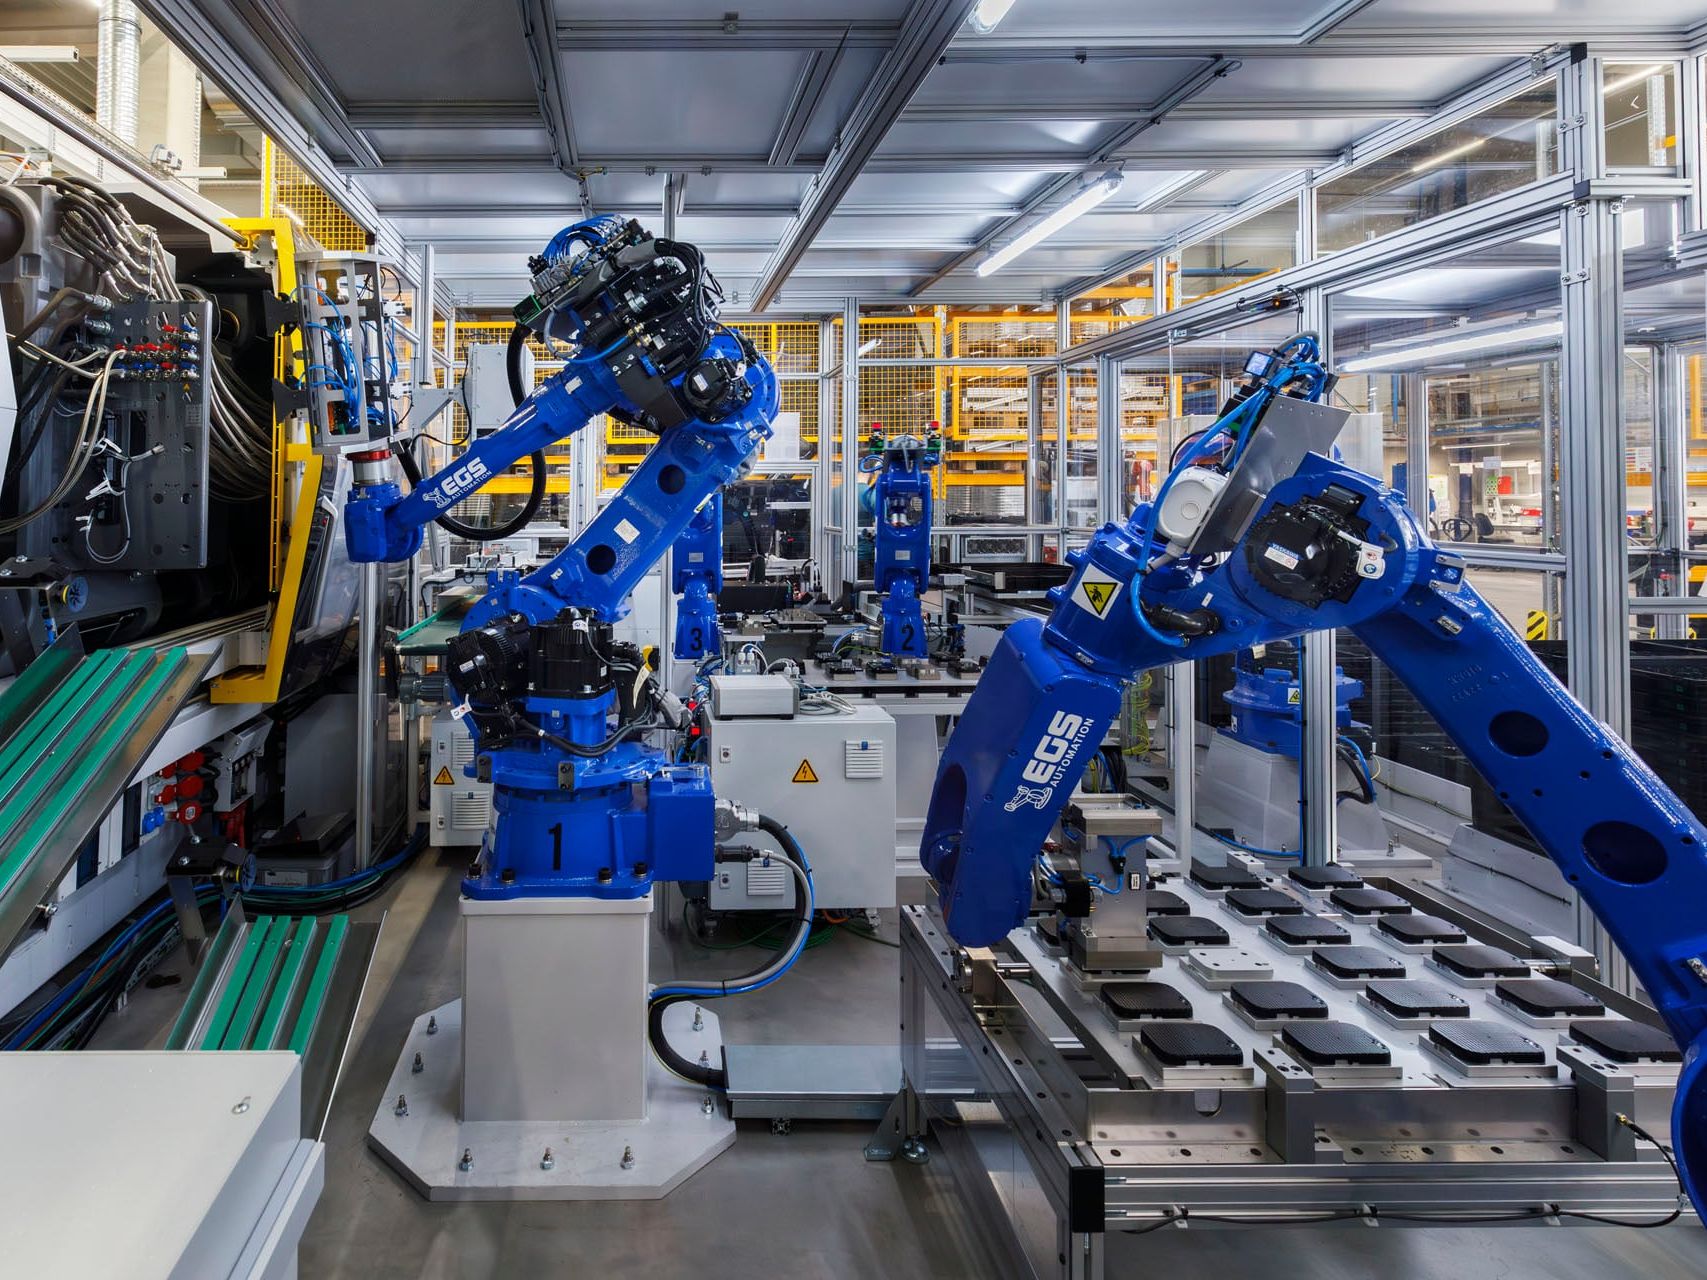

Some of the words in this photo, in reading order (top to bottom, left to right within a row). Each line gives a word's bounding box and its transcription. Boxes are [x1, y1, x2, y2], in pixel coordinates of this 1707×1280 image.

[441, 457, 487, 495] EGS
[452, 471, 492, 500] AUTOMATION
[691, 628, 702, 651] 3
[902, 625, 914, 650] 2
[1023, 710, 1083, 784] EGS
[1050, 718, 1094, 787] AUTOMATION
[548, 823, 562, 870] 1
